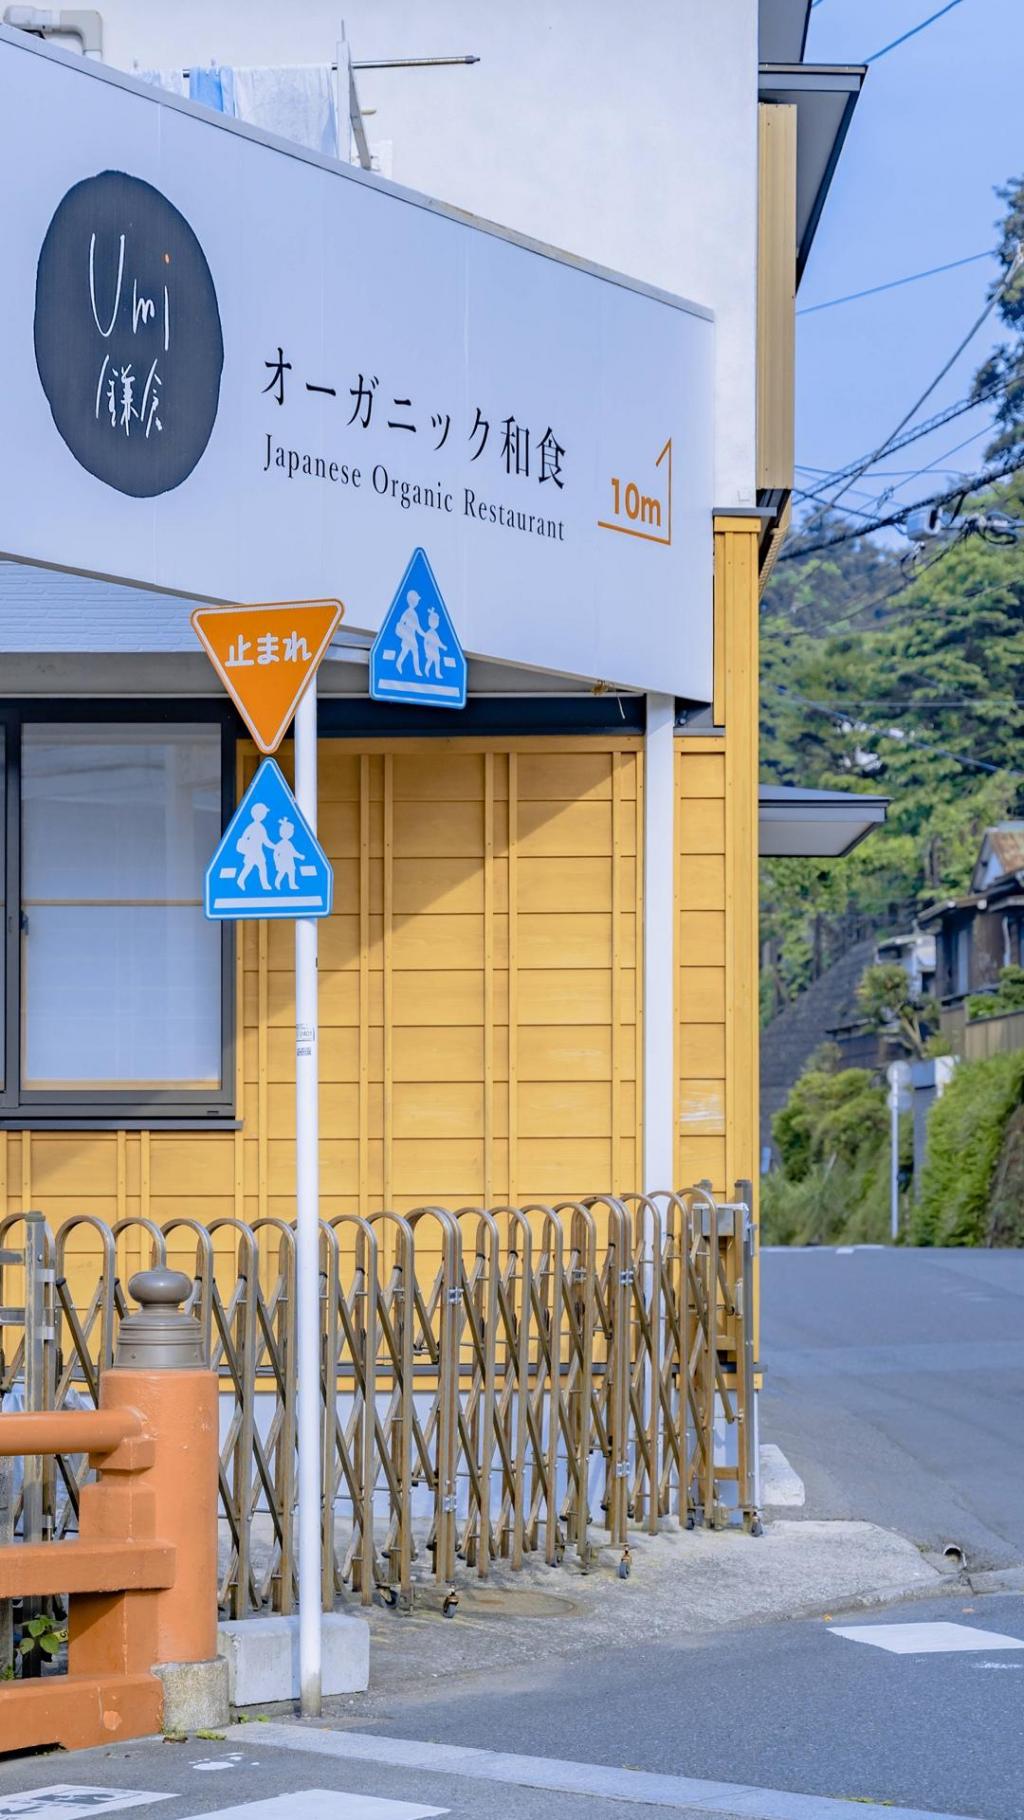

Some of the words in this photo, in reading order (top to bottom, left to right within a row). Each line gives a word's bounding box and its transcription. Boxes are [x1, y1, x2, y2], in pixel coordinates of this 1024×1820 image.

[88, 233, 171, 351] Umi
[261, 346, 567, 490] オーガニック和食
[263, 433, 363, 488] Japanese
[372, 464, 454, 509] Organic
[463, 488, 565, 541] Restaurant
[611, 477, 662, 527] 10m
[224, 630, 313, 668] 止まれ
